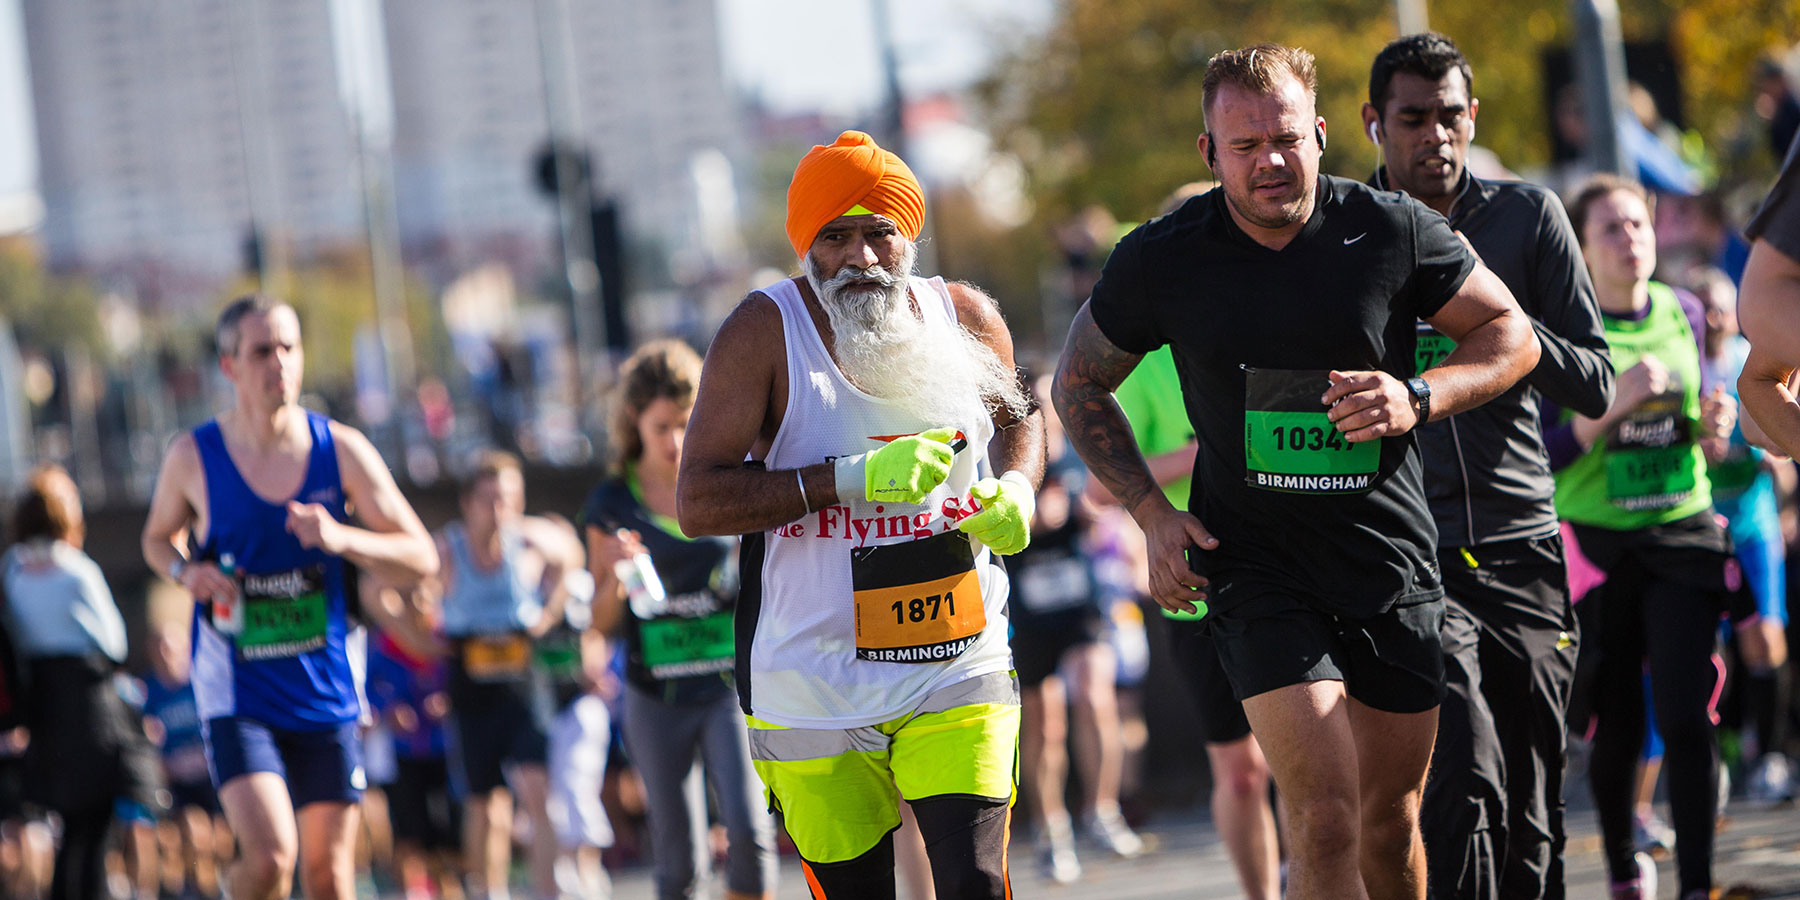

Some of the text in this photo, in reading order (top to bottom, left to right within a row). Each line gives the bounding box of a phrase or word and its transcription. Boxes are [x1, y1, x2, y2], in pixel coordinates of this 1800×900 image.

[1257, 473, 1368, 490] BIRMINGHAM
[816, 505, 933, 548] Flying
[891, 591, 955, 625] 1871
